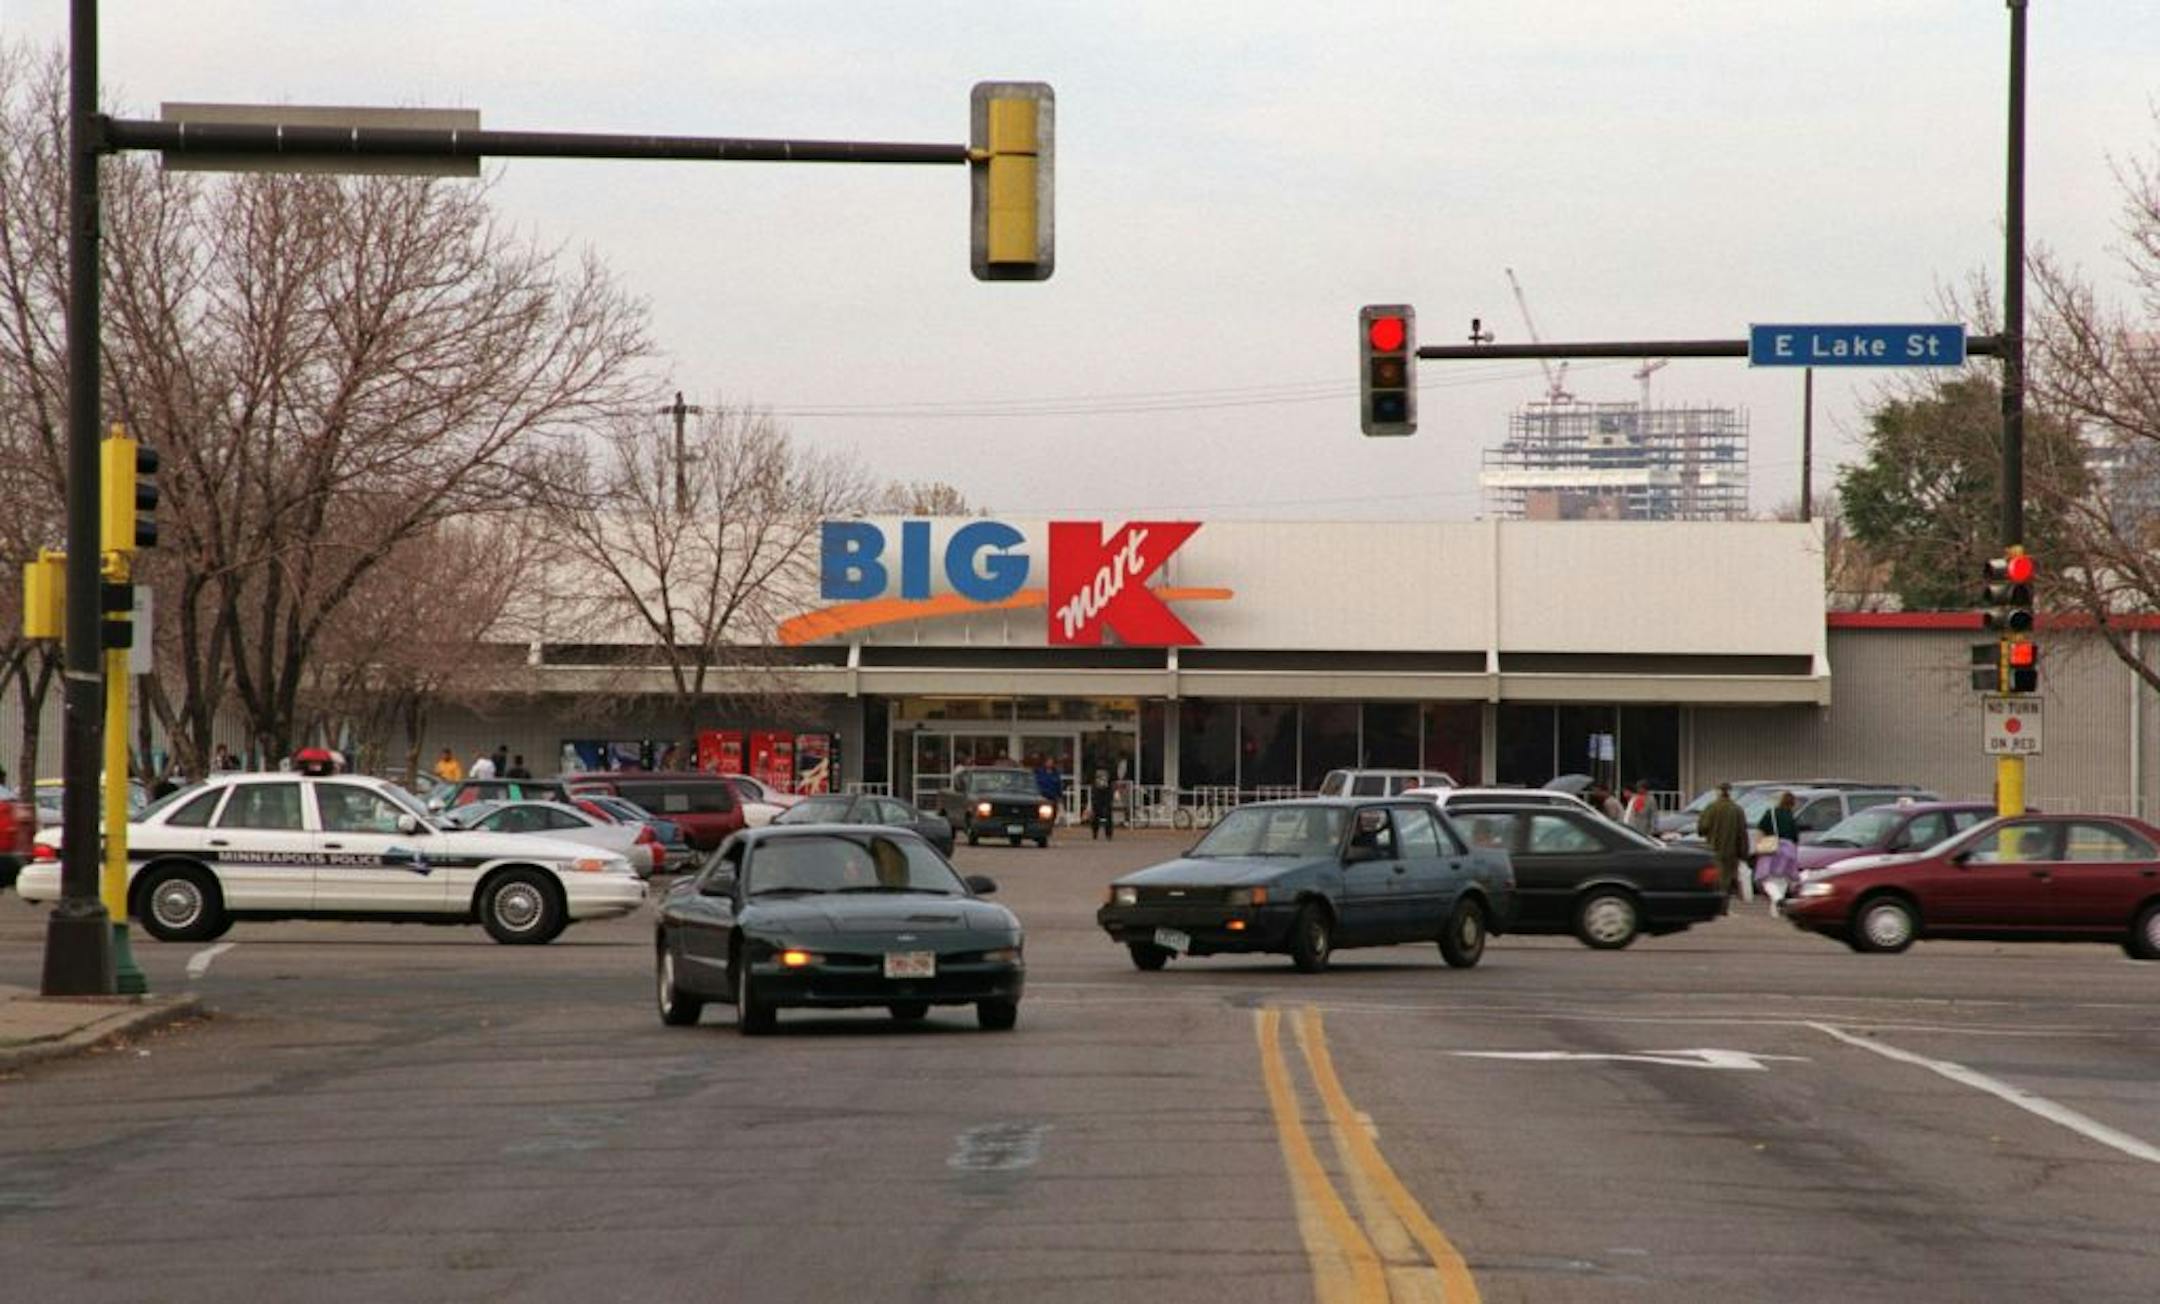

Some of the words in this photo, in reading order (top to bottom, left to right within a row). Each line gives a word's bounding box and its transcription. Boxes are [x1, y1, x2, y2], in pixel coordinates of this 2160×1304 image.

[1775, 334, 1793, 356] E
[1812, 334, 1887, 356] Lake
[1906, 334, 1940, 356] St
[820, 521, 1030, 602] BIG
[1056, 528, 1149, 640] mart
[1987, 702, 2004, 714] NO
[2008, 702, 2039, 714] TURN
[1990, 737, 2007, 750] ON
[2012, 737, 2036, 751] RED
[218, 851, 326, 865] MINNEAPOLIS
[330, 853, 382, 866] POLICE
